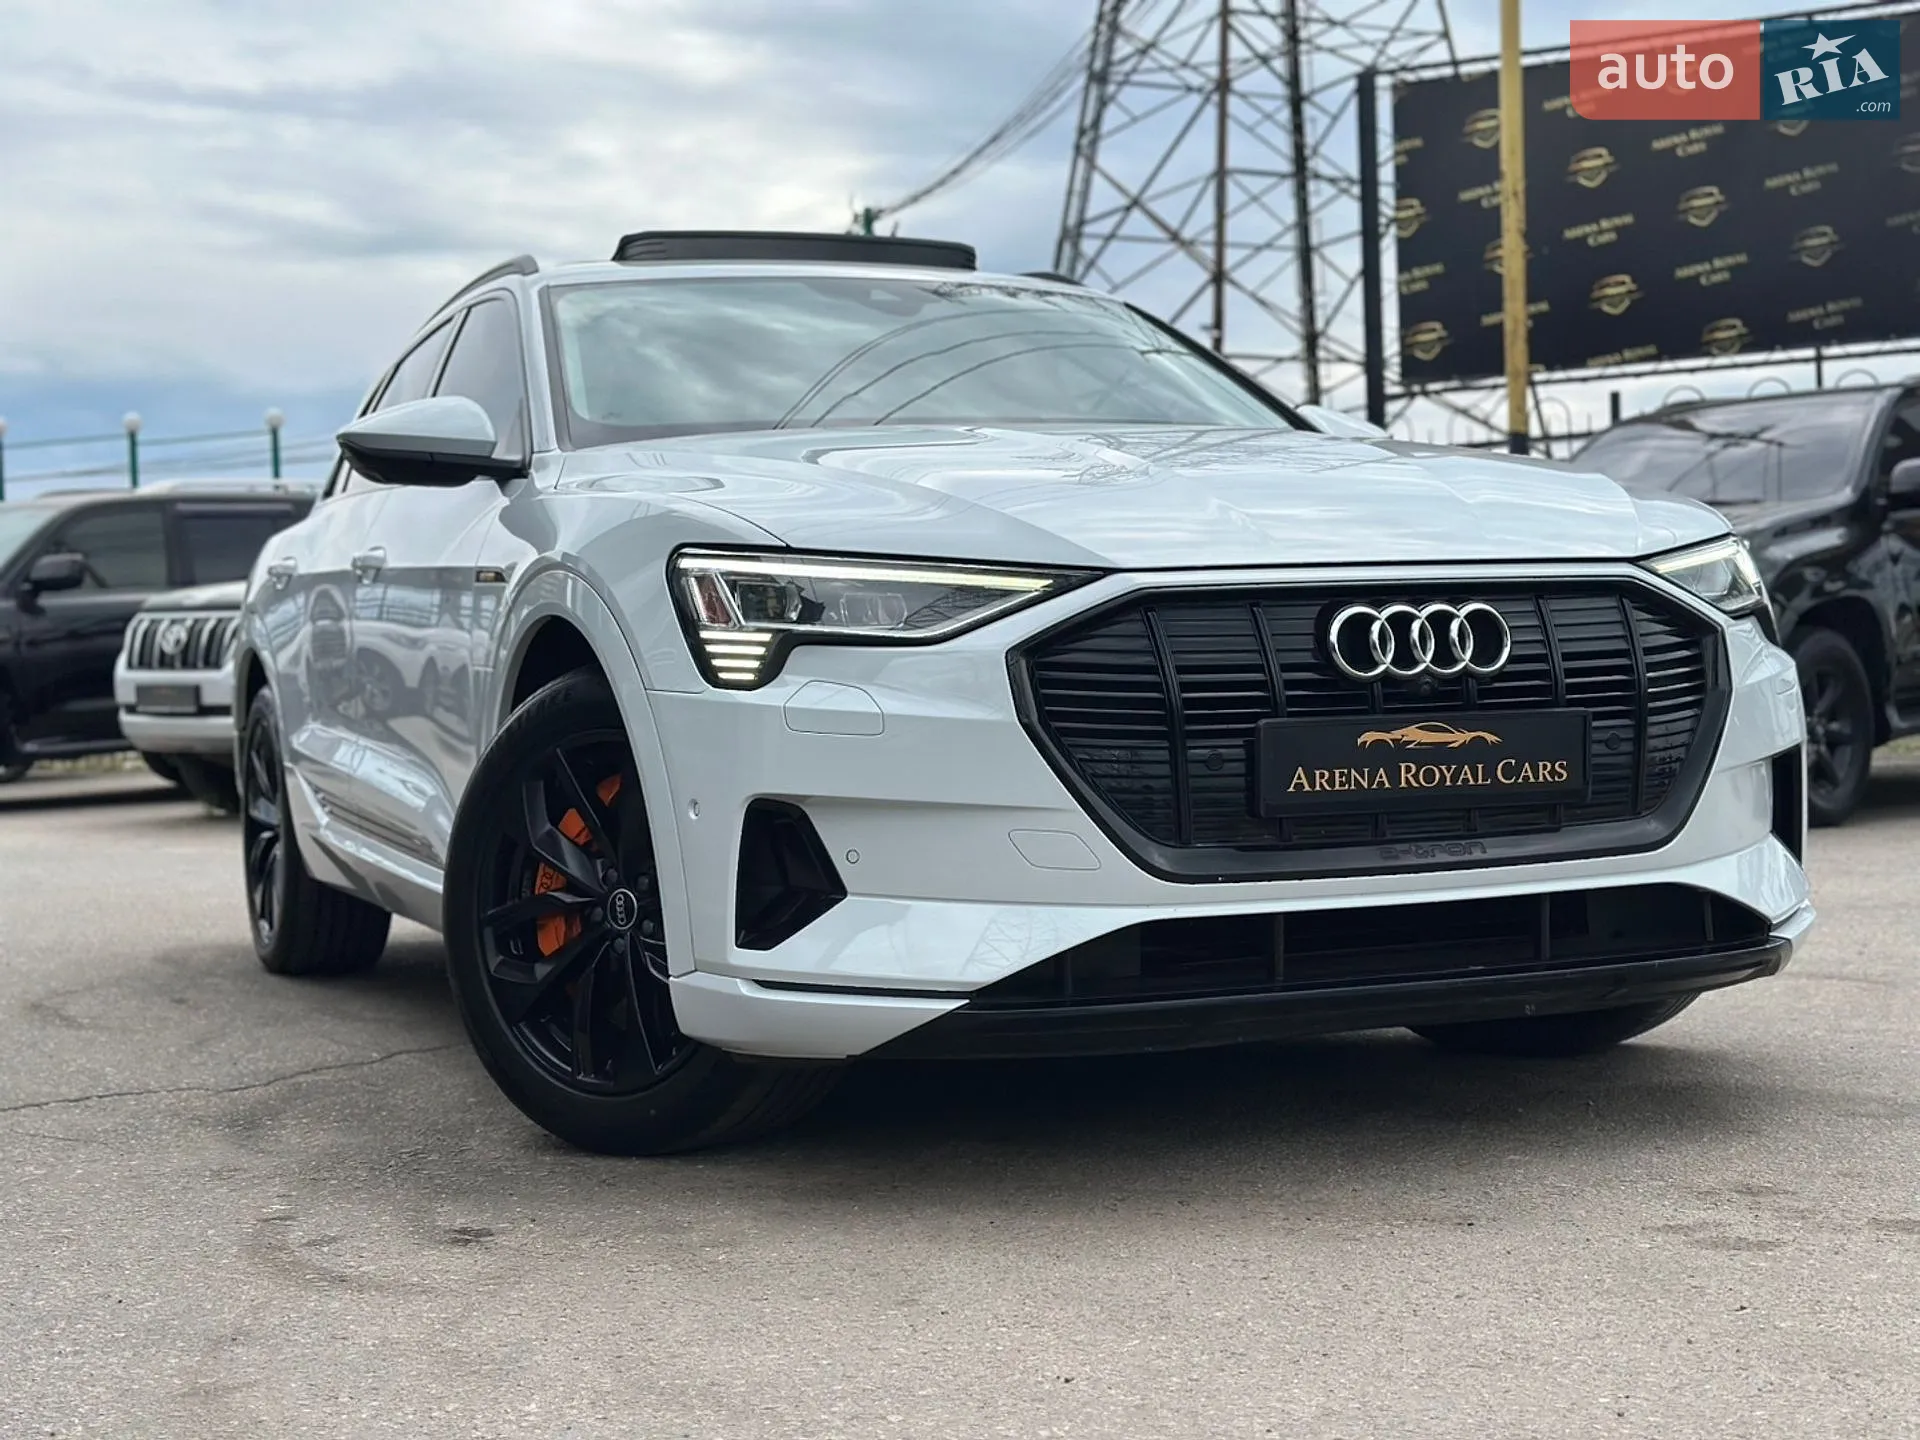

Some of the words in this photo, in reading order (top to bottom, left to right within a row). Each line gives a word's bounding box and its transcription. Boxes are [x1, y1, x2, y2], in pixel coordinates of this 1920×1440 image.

[1287, 766, 1392, 793] ARENA
[1398, 762, 1491, 788] ROYAL
[1496, 758, 1569, 784] CARS
[1379, 840, 1488, 861] e-tron
